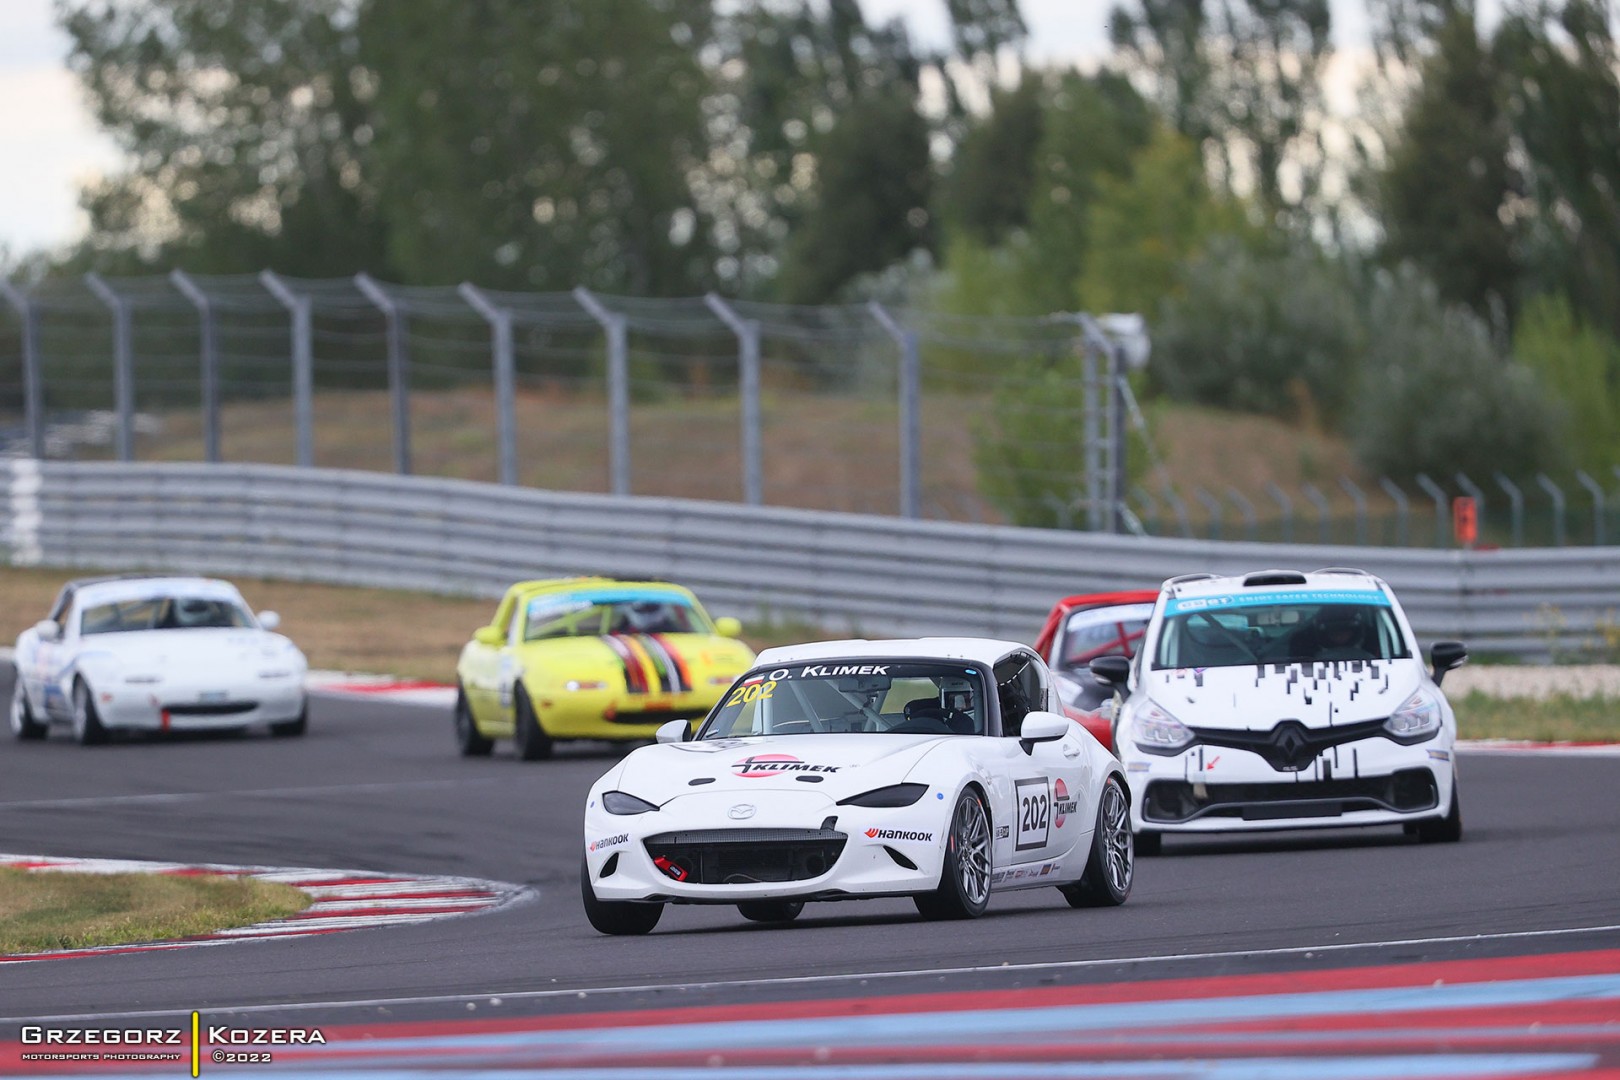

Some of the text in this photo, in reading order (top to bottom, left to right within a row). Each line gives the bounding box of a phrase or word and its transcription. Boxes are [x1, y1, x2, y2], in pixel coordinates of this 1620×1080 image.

[1311, 592, 1380, 600] TECHNOLOGY
[769, 665, 890, 681] O. KLIMEK
[726, 681, 777, 707] 202
[752, 763, 842, 773] KLIMEK
[1022, 794, 1047, 832] 202
